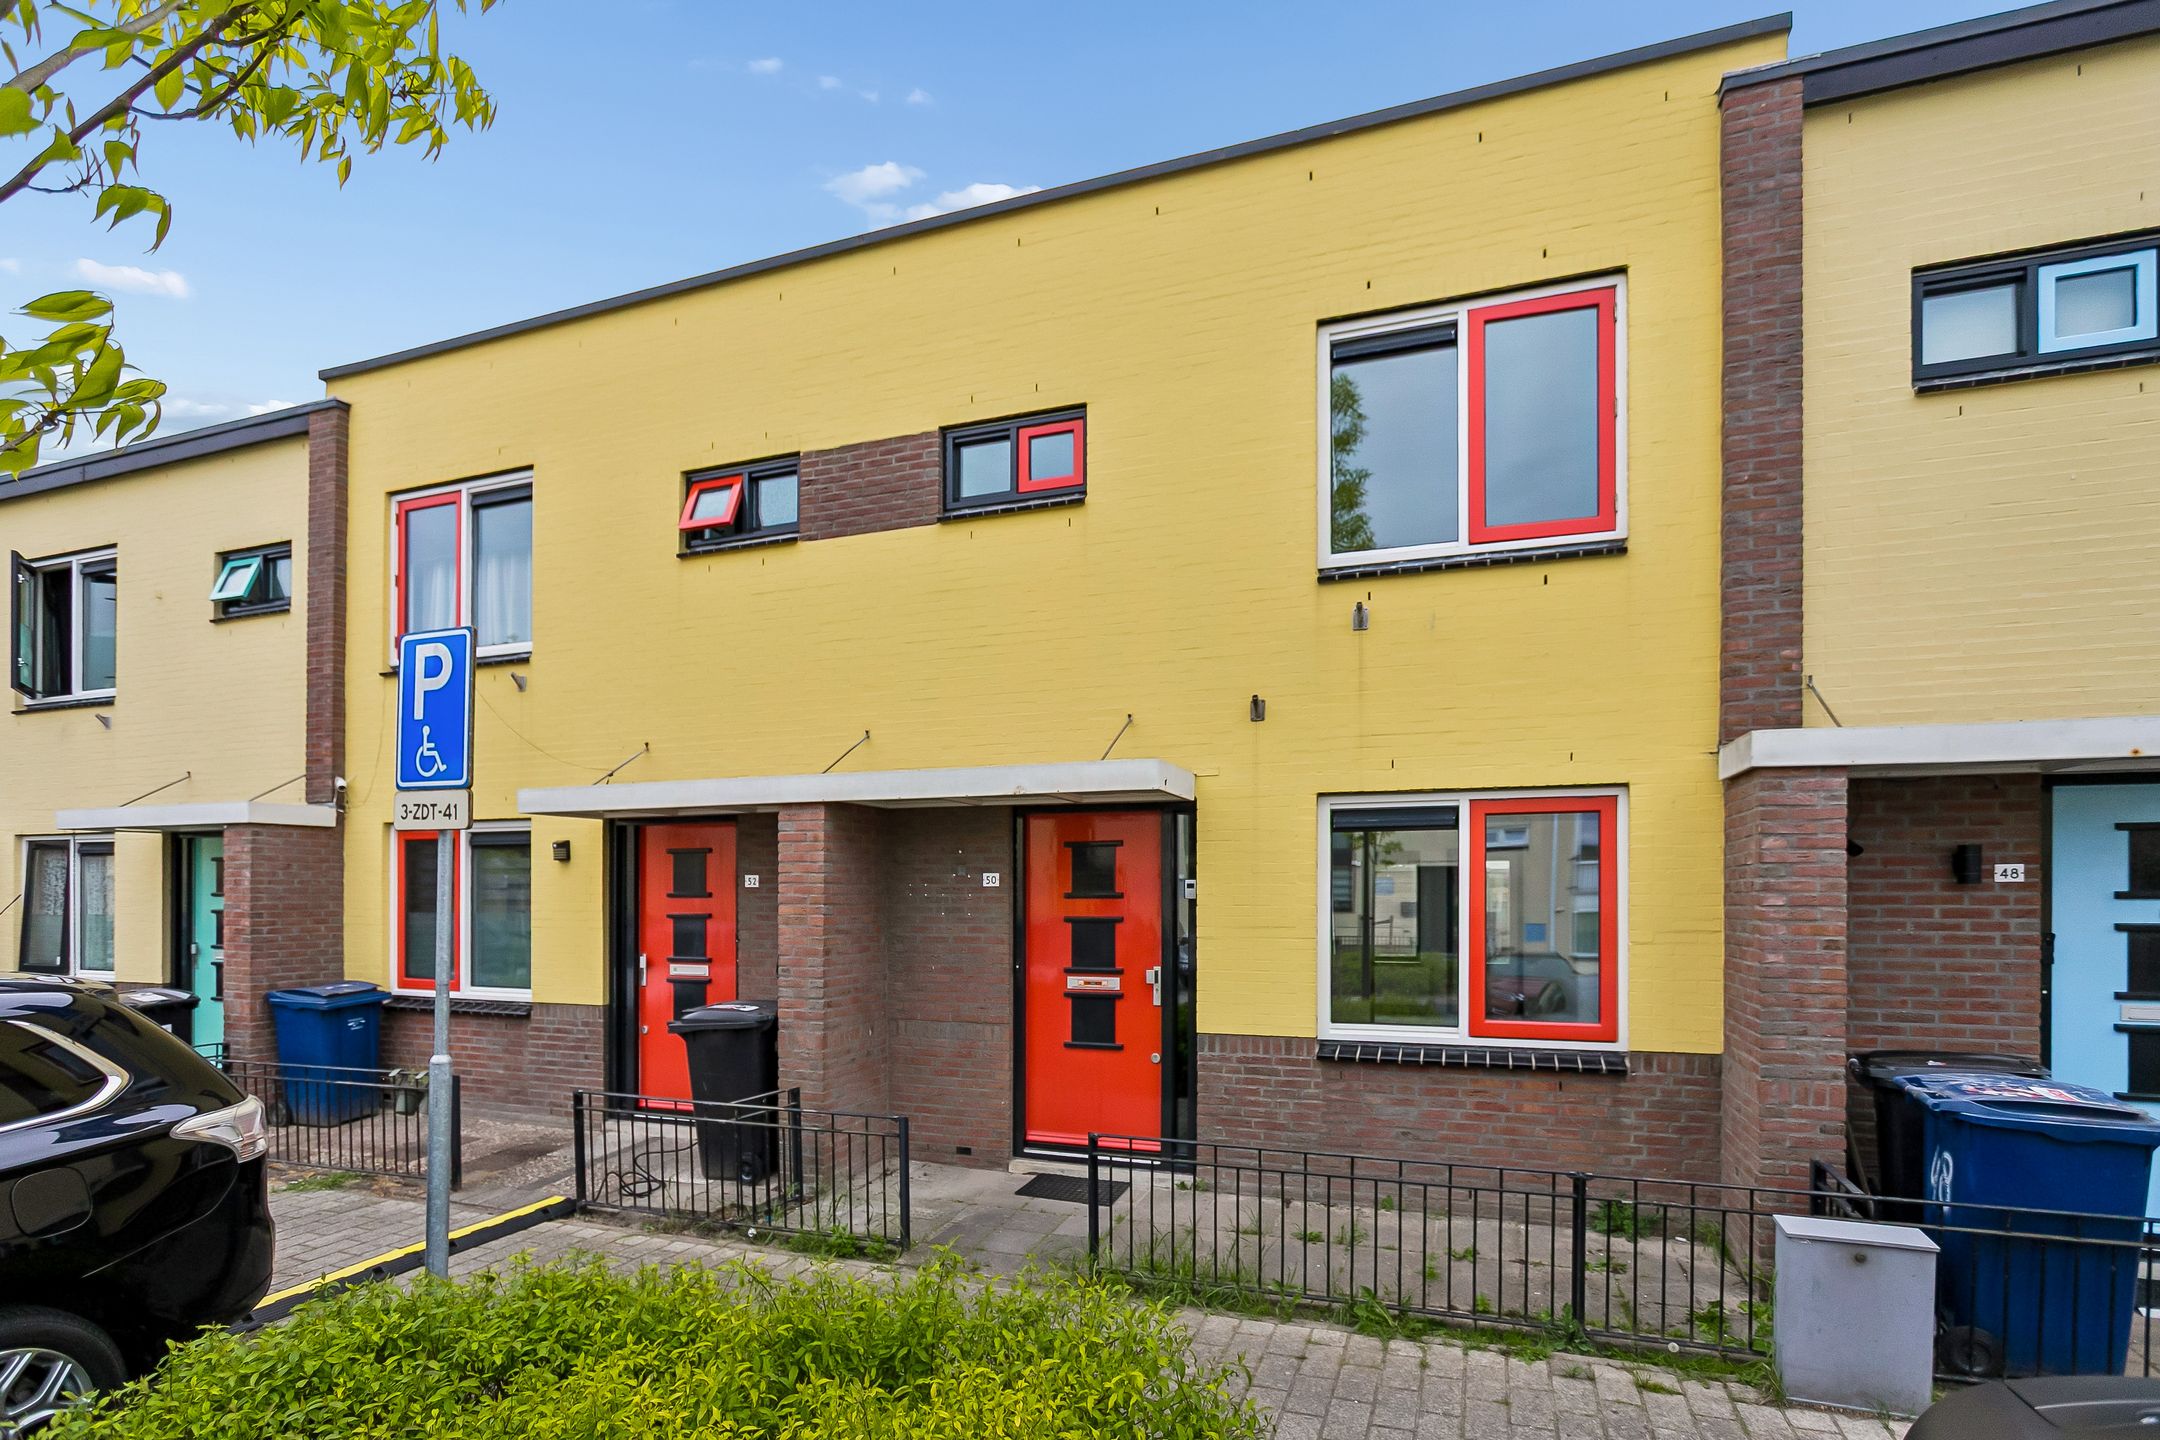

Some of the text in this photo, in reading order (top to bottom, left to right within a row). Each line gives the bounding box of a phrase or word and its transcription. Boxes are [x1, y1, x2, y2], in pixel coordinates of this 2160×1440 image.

[413, 642, 453, 721] P
[400, 803, 458, 821] 3-ZDT-41
[1999, 867, 2019, 879] 48
[747, 877, 757, 886] 52
[985, 875, 997, 885] 50
